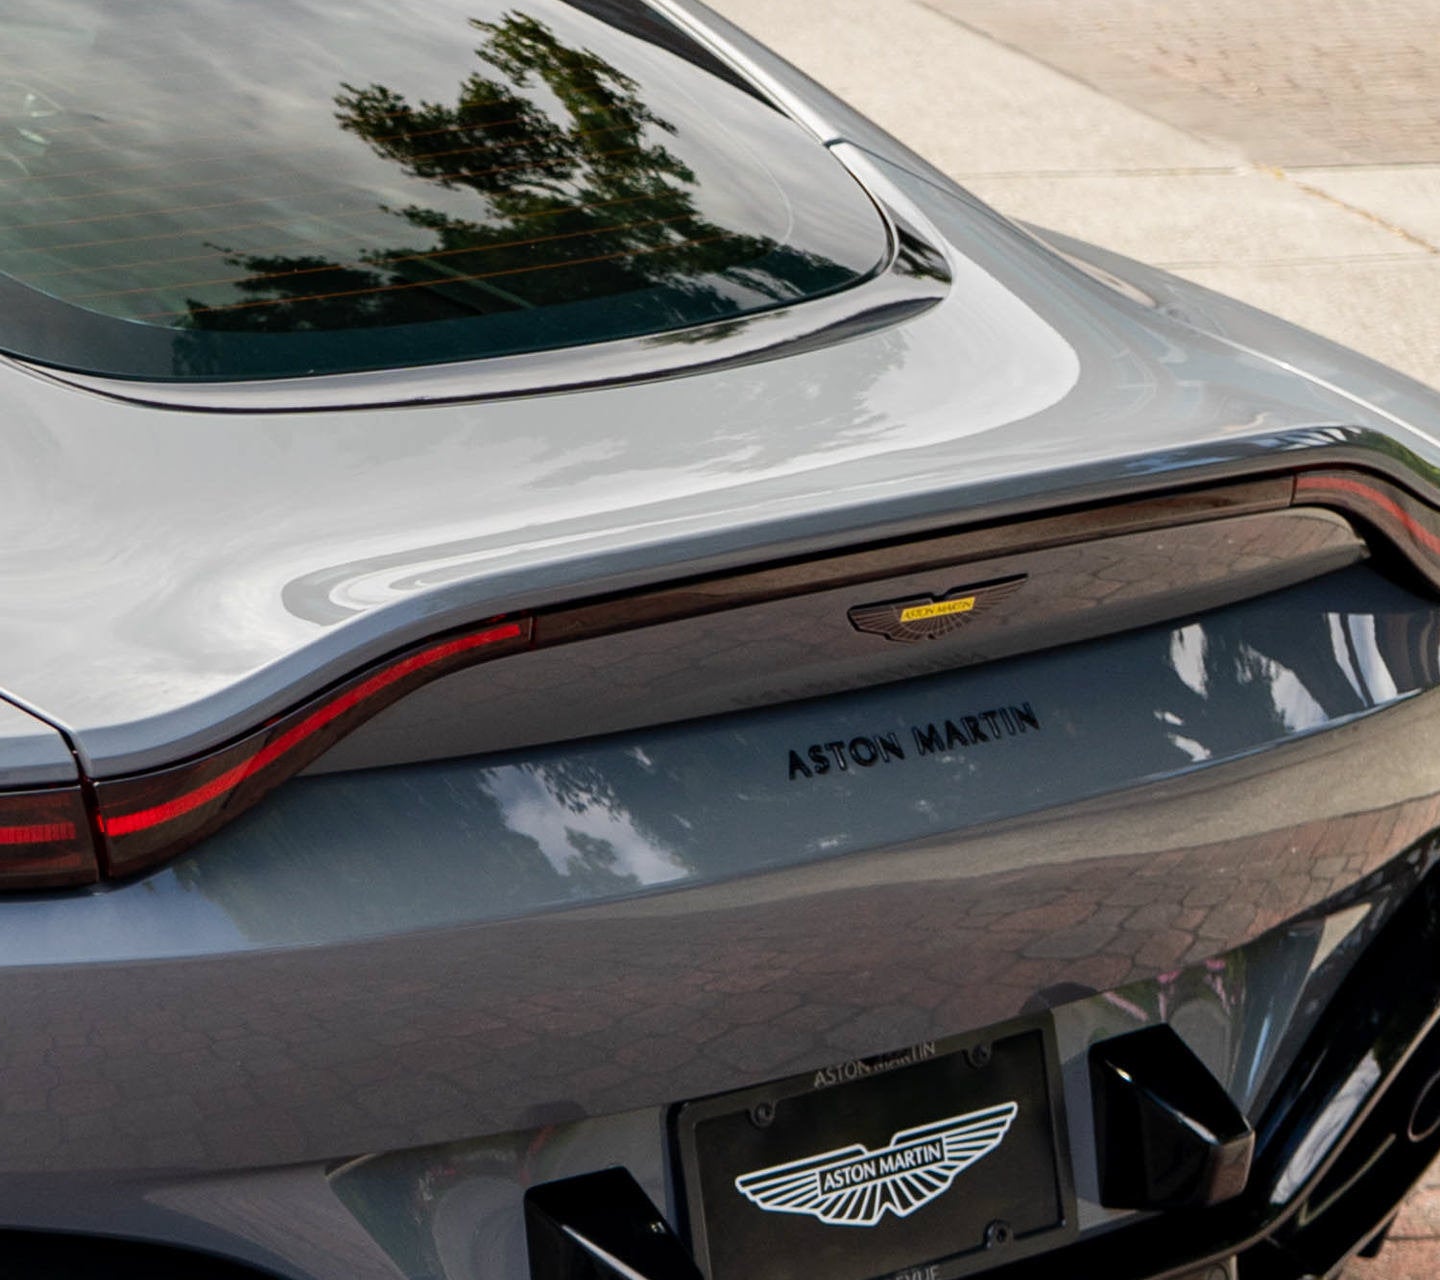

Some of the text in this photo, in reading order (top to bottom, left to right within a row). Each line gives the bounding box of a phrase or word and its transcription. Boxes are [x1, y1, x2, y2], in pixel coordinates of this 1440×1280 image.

[788, 701, 1040, 780] ASTON MARTIN
[814, 1059, 871, 1090] ASTON
[824, 1141, 942, 1192] ASTON MARTIN
